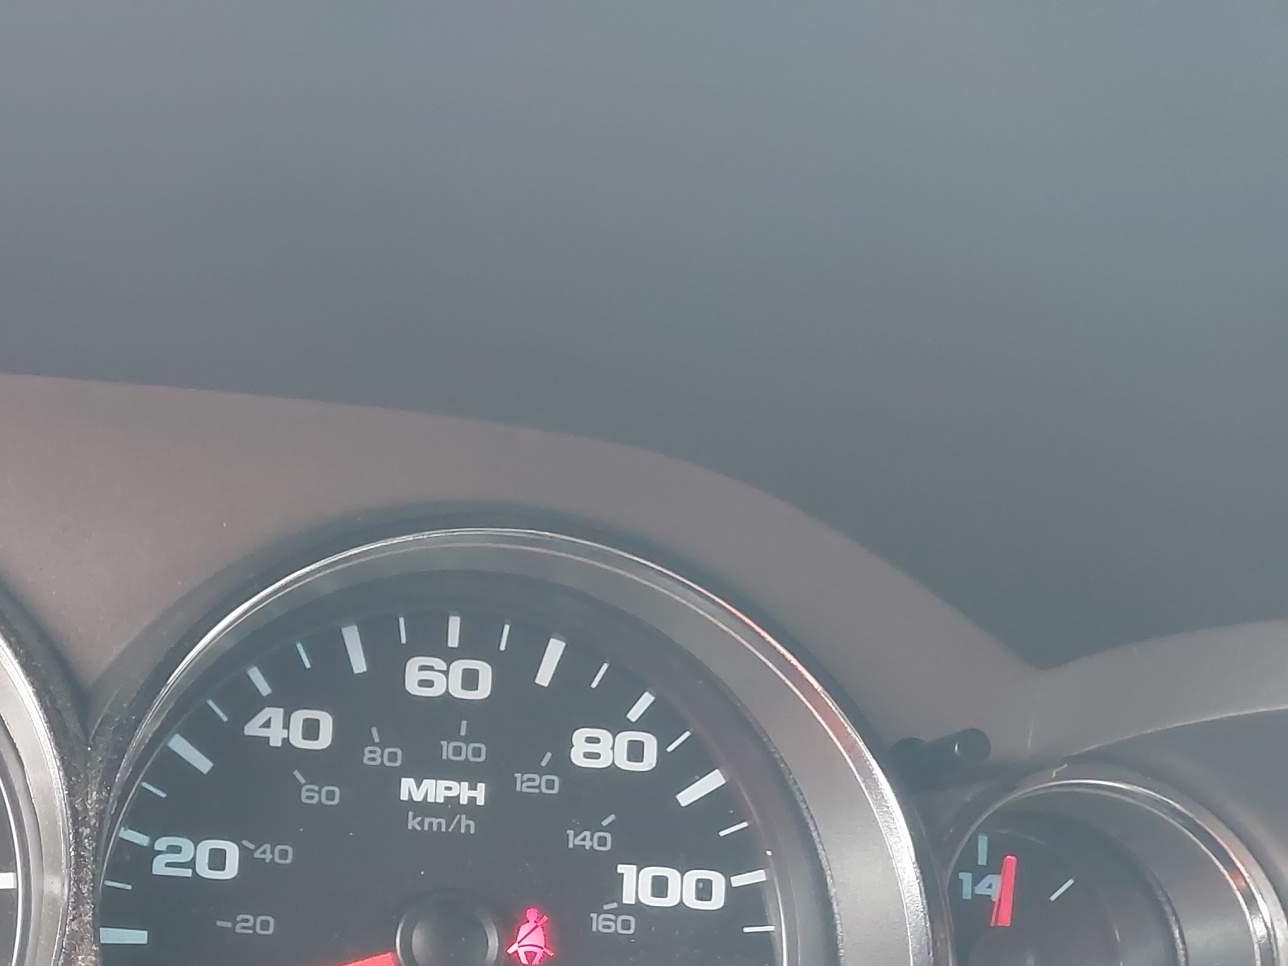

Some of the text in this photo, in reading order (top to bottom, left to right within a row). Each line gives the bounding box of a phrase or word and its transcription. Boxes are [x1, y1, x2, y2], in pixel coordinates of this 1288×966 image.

[404, 656, 492, 700] 60
[243, 706, 334, 750] 40
[362, 746, 403, 768] 80
[440, 740, 487, 763] 100
[569, 728, 658, 772] 80
[301, 784, 340, 807] 60
[400, 777, 485, 806] MPH
[514, 773, 560, 795] 120
[407, 811, 476, 835] km/h
[567, 829, 612, 852] 140
[152, 836, 239, 880] 20
[253, 843, 293, 865] 40
[617, 864, 725, 911] 100
[958, 871, 1002, 902] 14
[235, 914, 275, 936] 20
[591, 913, 636, 935] 160
